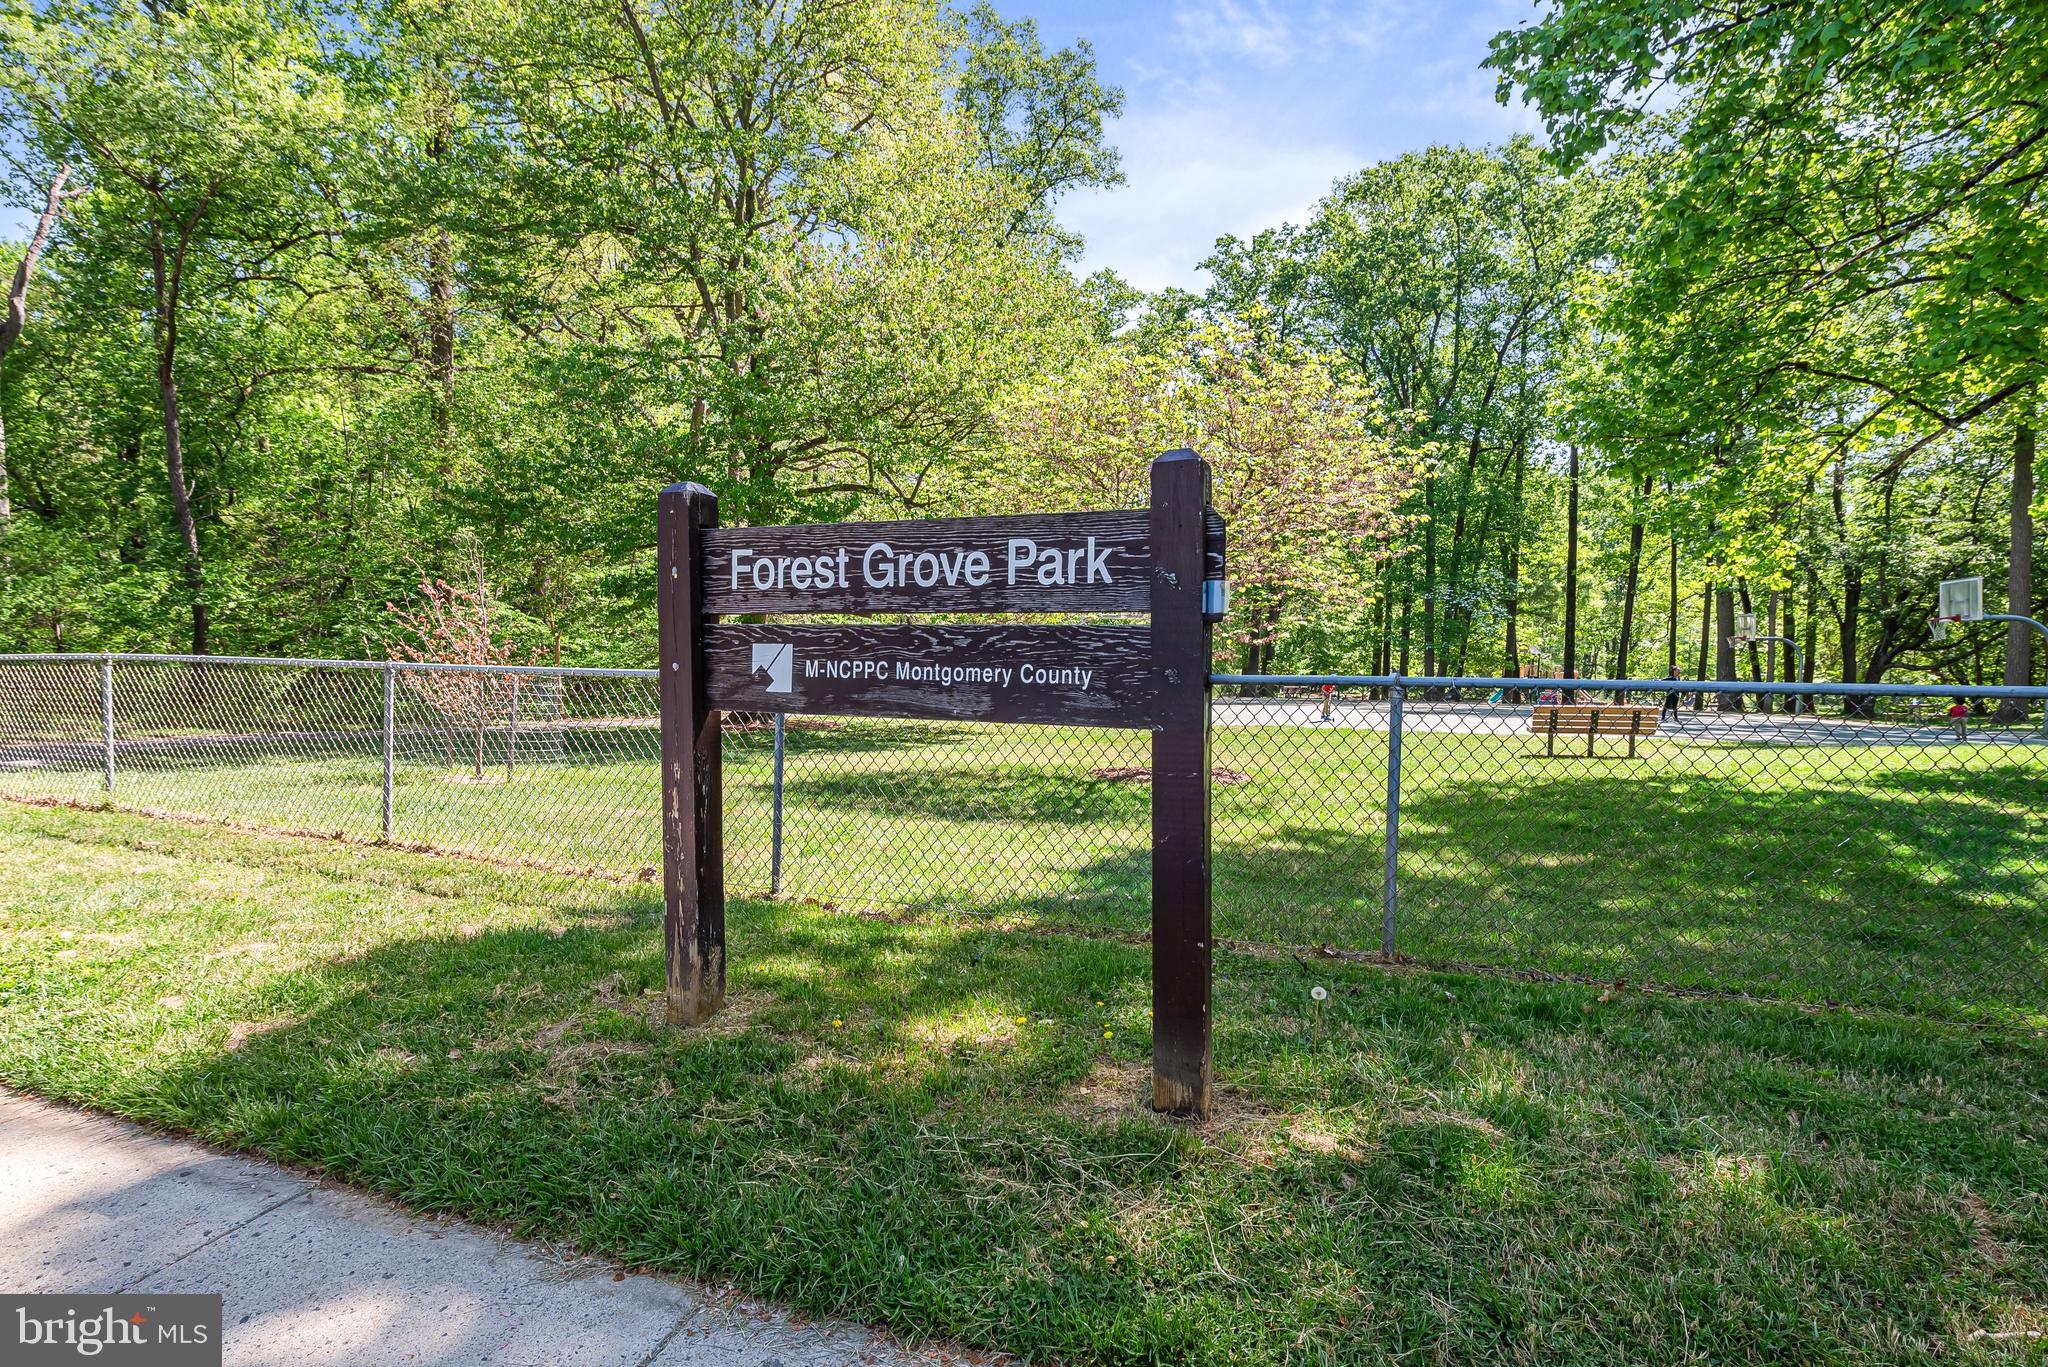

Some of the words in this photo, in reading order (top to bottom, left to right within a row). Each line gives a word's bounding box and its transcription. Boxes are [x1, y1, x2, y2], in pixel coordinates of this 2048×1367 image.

[731, 547, 850, 590] Forest
[863, 542, 990, 587] Grove
[1007, 536, 1113, 586] Park
[805, 659, 889, 681] M-NCPPC
[895, 661, 1013, 687] Montgomery
[1019, 663, 1093, 690] County
